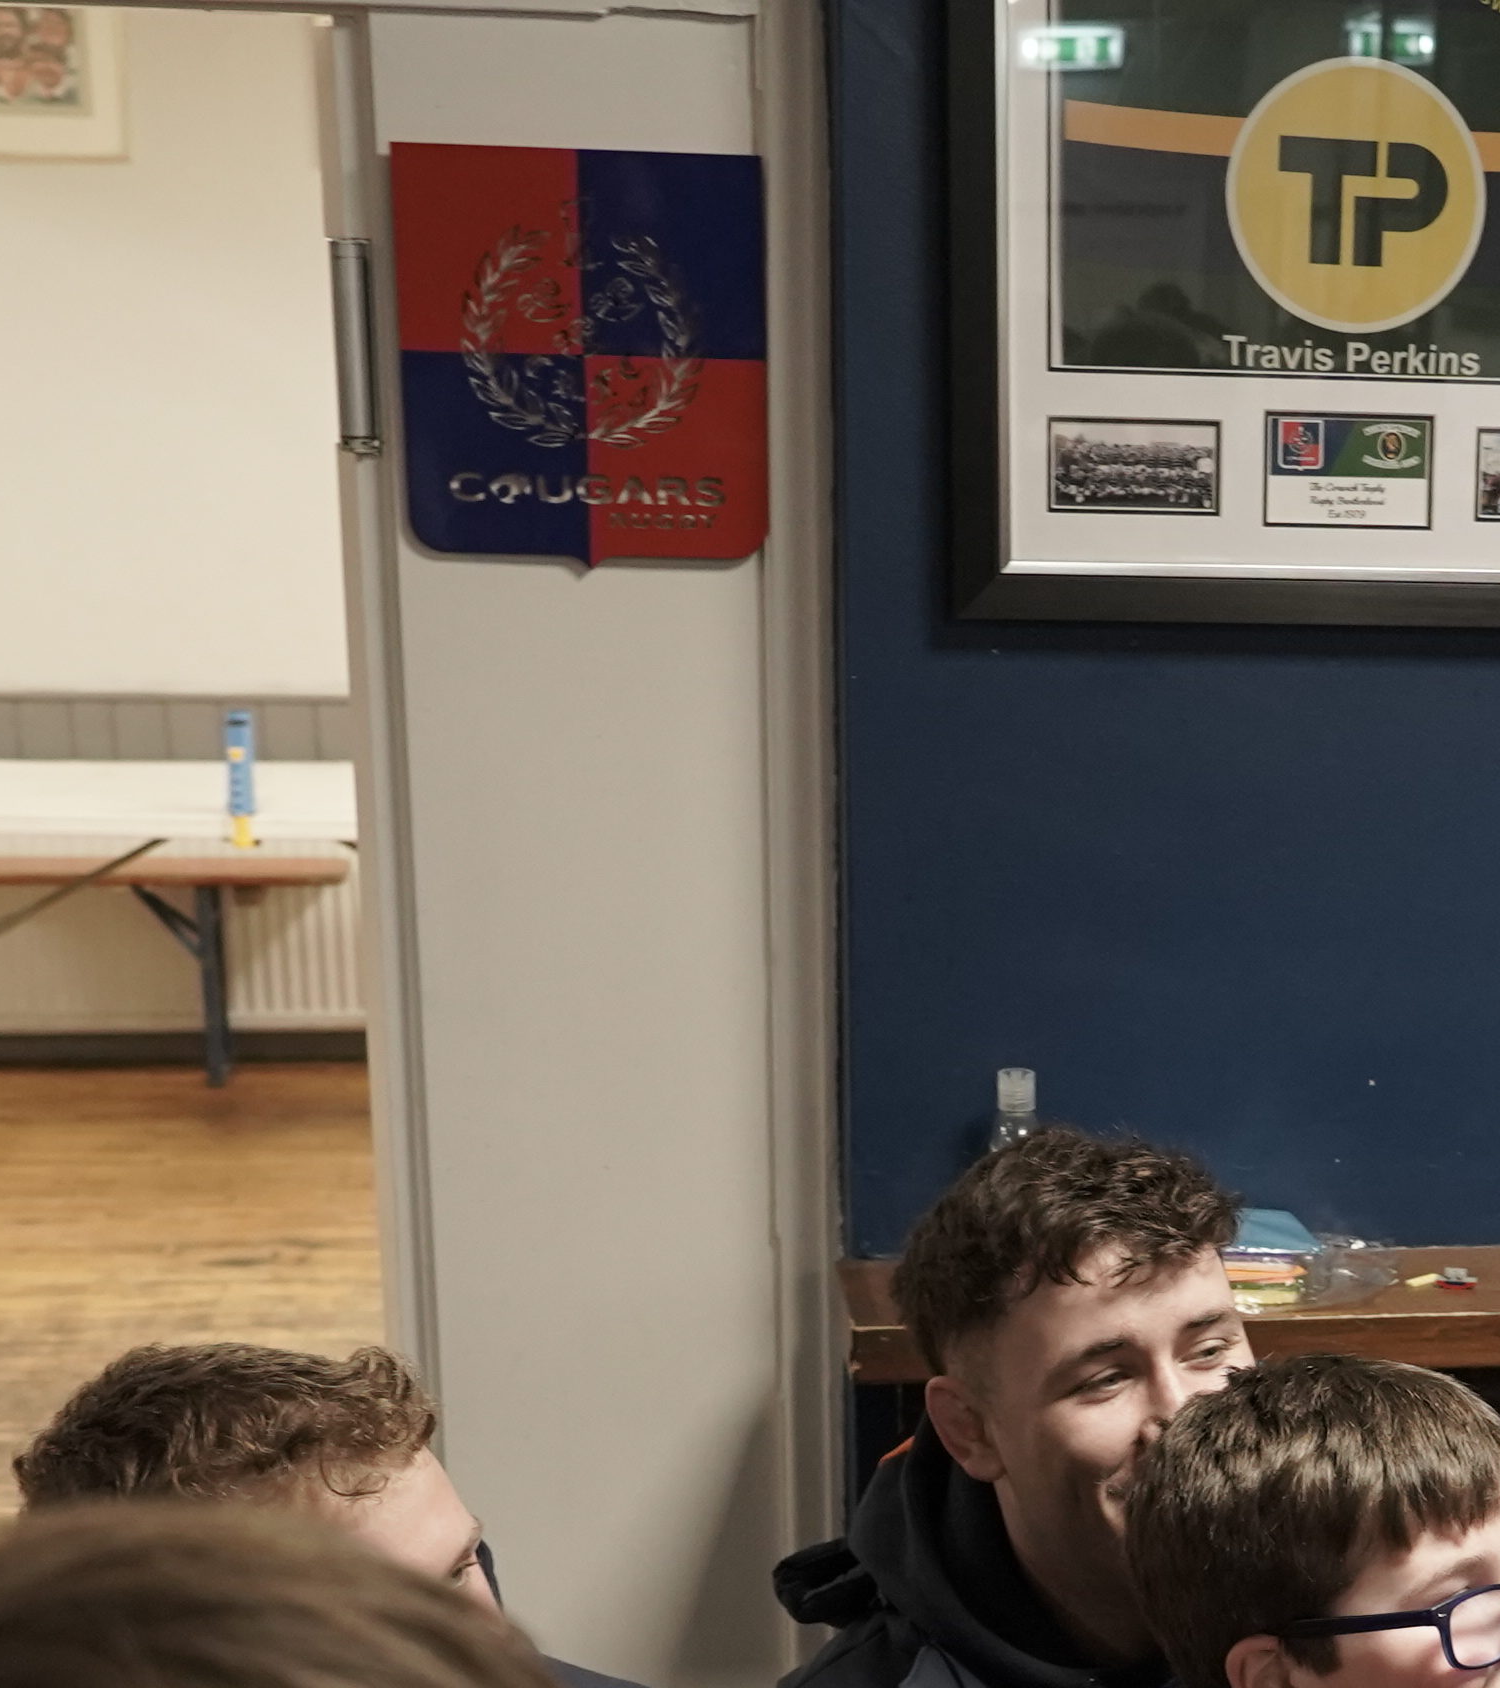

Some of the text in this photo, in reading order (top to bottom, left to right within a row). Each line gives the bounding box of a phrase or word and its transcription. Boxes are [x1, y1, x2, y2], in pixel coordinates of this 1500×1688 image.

[1278, 135, 1448, 267] TP
[1222, 334, 1481, 376] Travis Perkins
[449, 471, 727, 506] COUGARS
[610, 513, 717, 530] RUGBY
